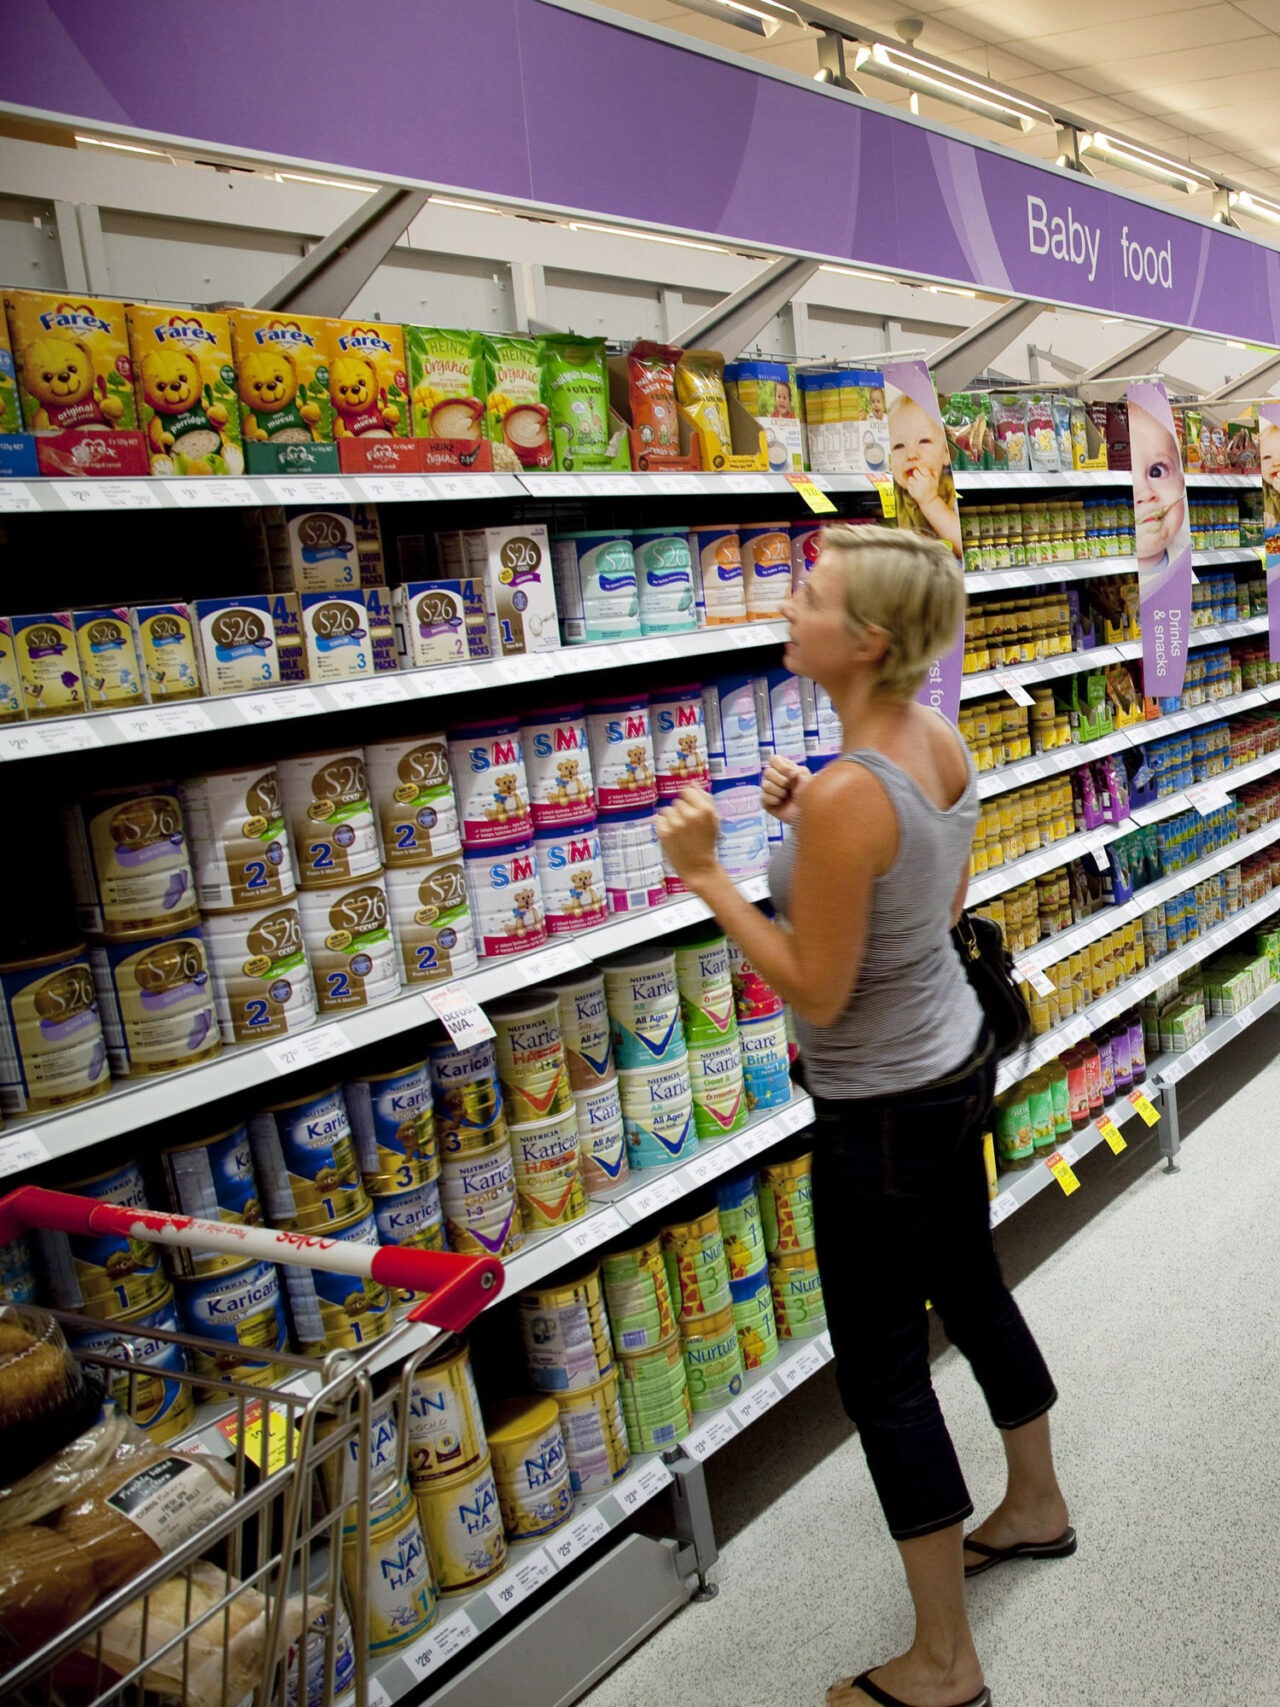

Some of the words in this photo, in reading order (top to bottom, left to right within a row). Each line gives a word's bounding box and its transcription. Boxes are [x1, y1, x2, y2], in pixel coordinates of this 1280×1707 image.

[1027, 194, 1100, 282] Baby
[1120, 226, 1173, 289] food
[39, 310, 112, 335] Farex
[154, 324, 218, 346] Farex
[254, 327, 315, 348] Farex
[338, 334, 392, 353] Farex
[430, 339, 465, 356] HEINZ
[501, 349, 534, 364] HEINZ
[424, 358, 470, 377] Organic
[497, 367, 538, 385] Organic
[57, 403, 93, 421] original
[267, 414, 294, 429] muesli
[170, 414, 207, 433] porridge
[353, 416, 378, 431] muesli
[278, 447, 315, 464] Farex
[366, 444, 400, 462] Farex
[343, 566, 353, 582] 3
[361, 575, 383, 586] PACKS
[1153, 610, 1166, 621] &
[466, 625, 486, 636] LIQUID
[501, 620, 515, 643] 1
[1169, 609, 1182, 657] Drinks
[371, 638, 395, 648] LIQUID
[455, 639, 463, 655] 2
[469, 646, 489, 657] PACKS
[1154, 627, 1167, 677] snacks
[357, 653, 367, 668] 3
[374, 660, 397, 671] PACKS
[261, 663, 272, 681] 3
[70, 690, 79, 702] 2
[130, 682, 139, 693] 3
[395, 824, 417, 849] 2
[310, 843, 334, 869] 2
[245, 861, 268, 890] 2
[415, 945, 438, 970] 2
[741, 961, 751, 972] 6
[326, 972, 351, 997] 2
[630, 972, 665, 983] NUTRICIA
[632, 978, 676, 1001] Karic
[245, 999, 270, 1026] 2
[442, 1004, 477, 1022] across
[635, 1016, 647, 1025] All
[649, 1013, 669, 1024] Ages
[449, 1018, 475, 1036] WA.
[507, 1019, 547, 1032] NUTRICIA
[510, 1026, 561, 1052] Karic
[742, 1034, 776, 1051] icare
[746, 1051, 778, 1066] Birth
[704, 1078, 723, 1087] Goat
[391, 1087, 431, 1111] Karic
[713, 1087, 736, 1099] months
[307, 1112, 347, 1139] Karic
[653, 1117, 664, 1126] All
[666, 1112, 684, 1124] Ages
[446, 1132, 461, 1152] 3
[520, 1129, 559, 1142] NUTRICIA
[459, 1158, 499, 1175] NUTRICIA
[396, 1166, 413, 1188] 3
[463, 1164, 514, 1194] Karica
[322, 1198, 335, 1219] 1
[389, 1200, 439, 1229] Karica
[466, 1205, 484, 1217] 1-3
[203, 1279, 248, 1296] NUTRICIA
[705, 1266, 719, 1295] 3
[114, 1285, 128, 1307] 1
[792, 1298, 807, 1324] 3
[350, 1322, 363, 1343] 1
[690, 1368, 708, 1397] 3
[414, 1448, 433, 1471] 2
[118, 1476, 153, 1500] Freshly
[149, 1461, 173, 1477] baked
[528, 1471, 550, 1490] HA
[558, 1490, 570, 1511] 3
[467, 1514, 491, 1535] HA
[390, 1570, 417, 1591] HA
[417, 1590, 429, 1611] 1
